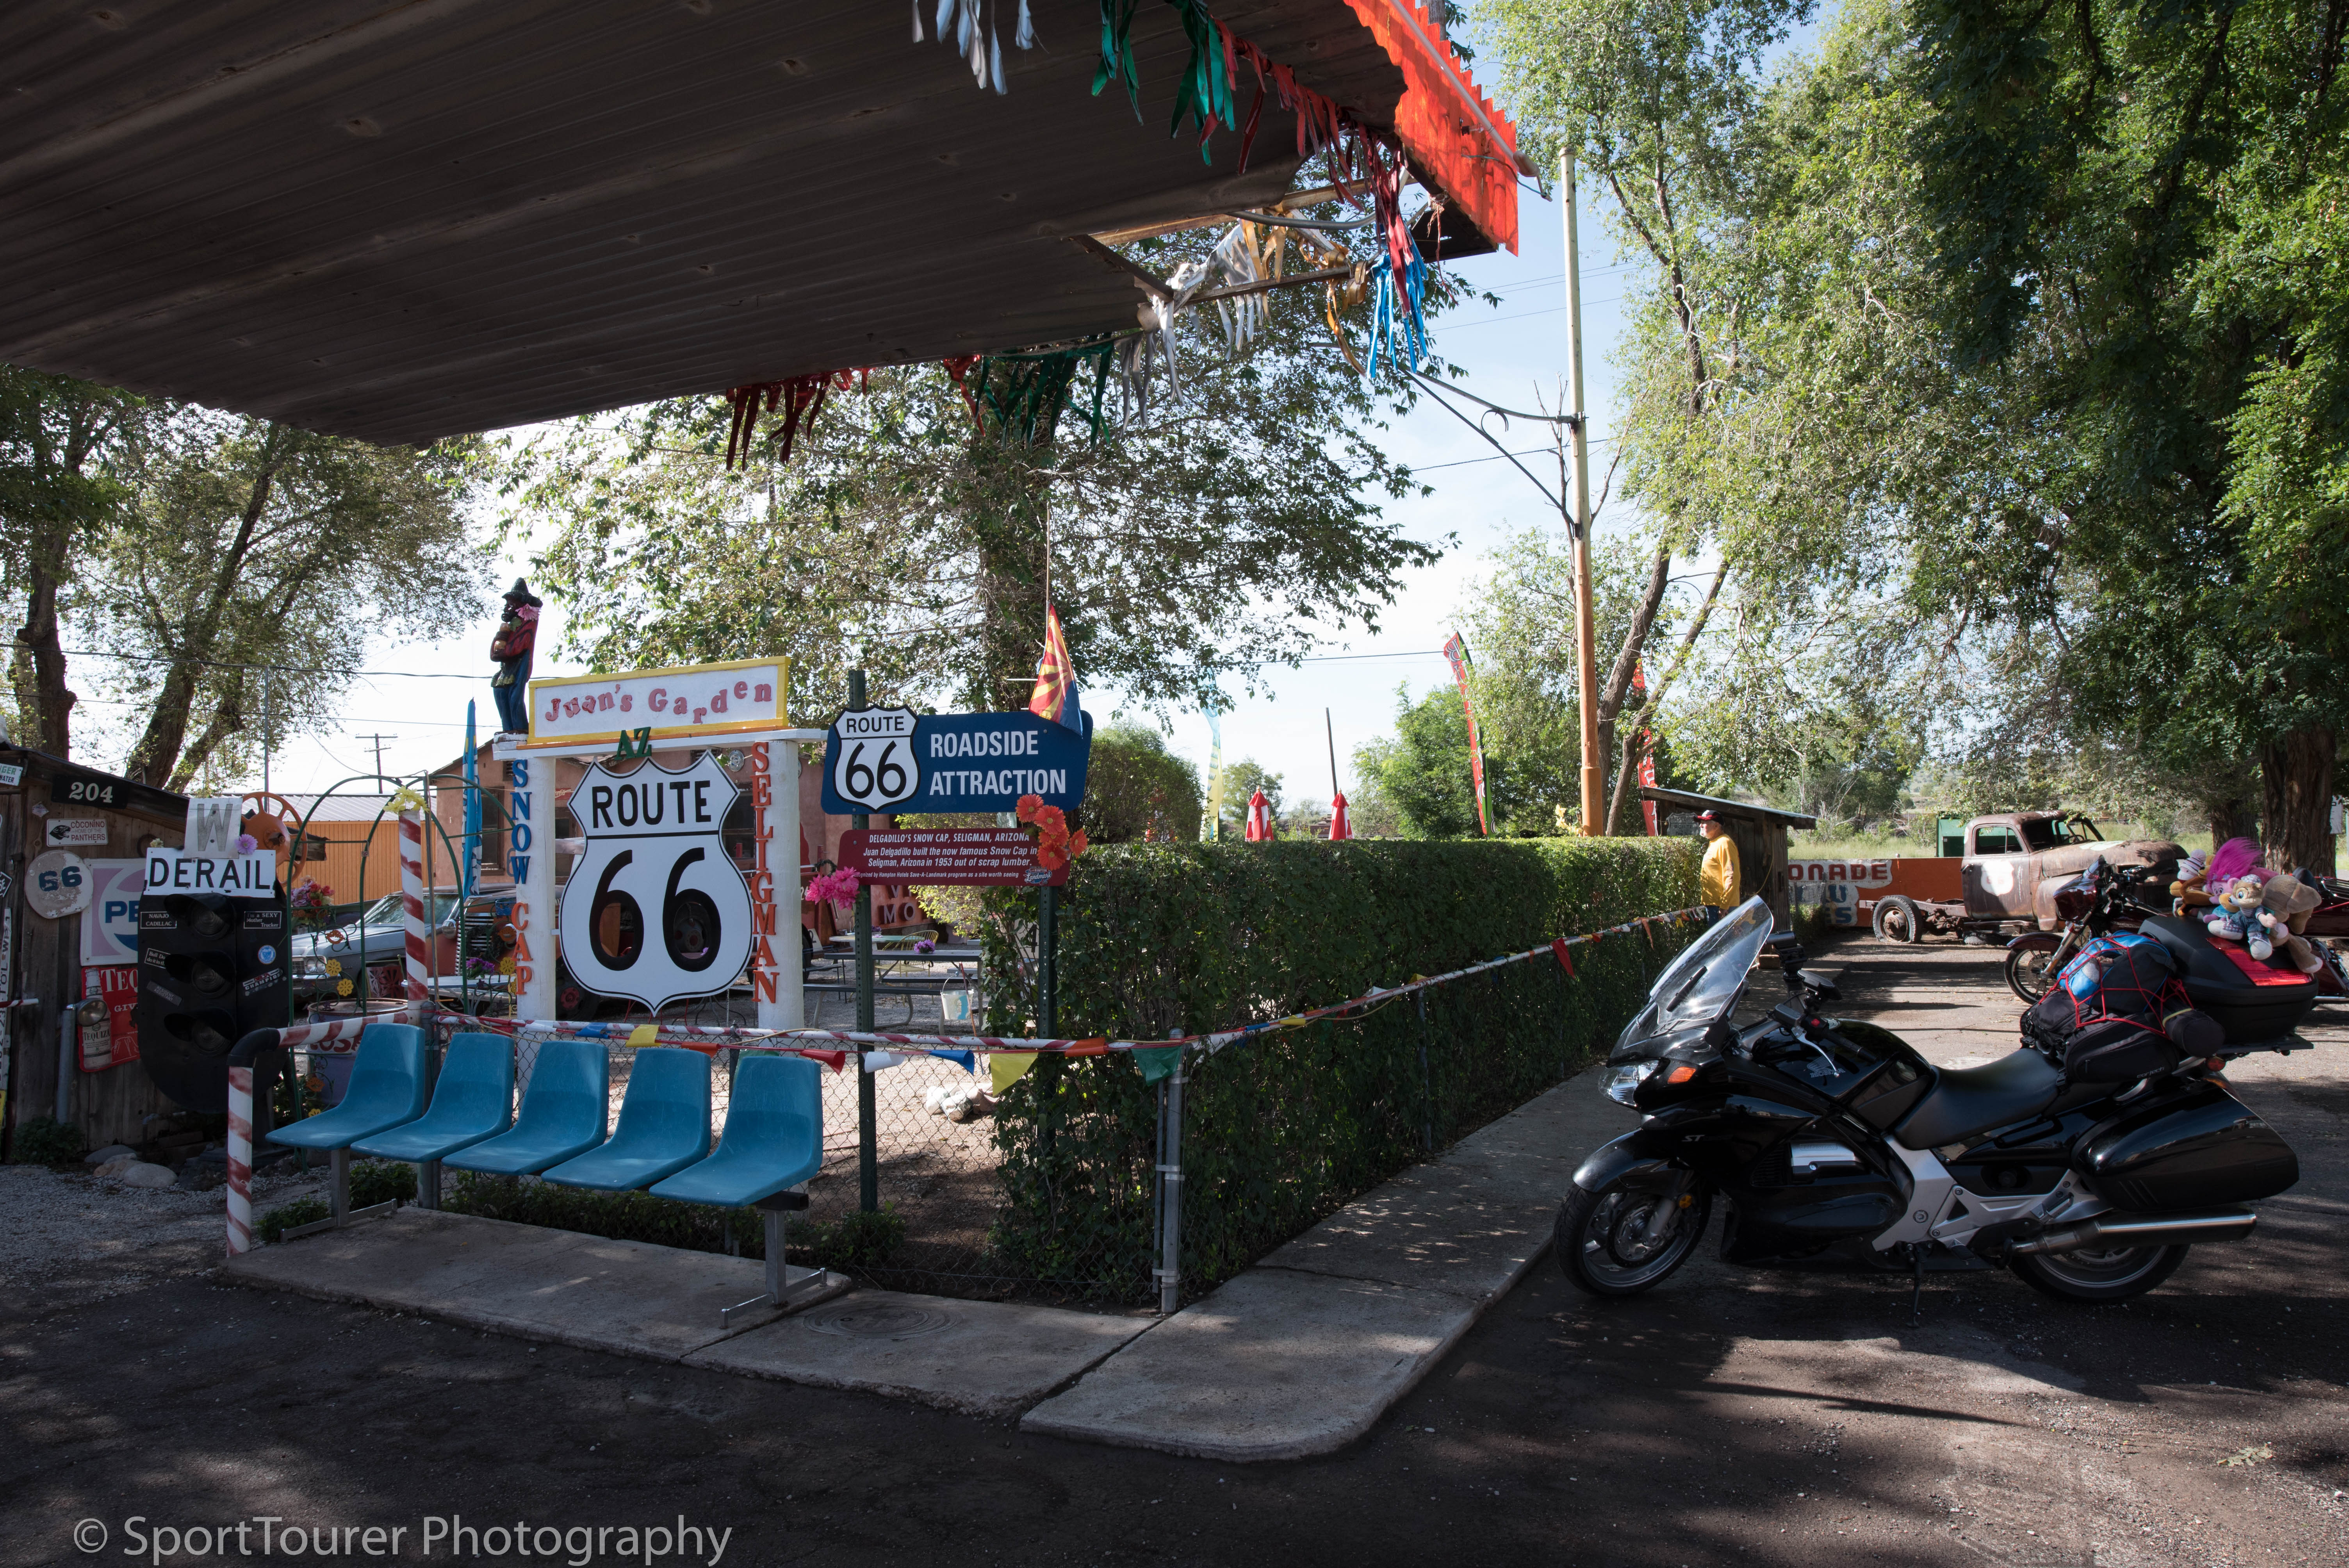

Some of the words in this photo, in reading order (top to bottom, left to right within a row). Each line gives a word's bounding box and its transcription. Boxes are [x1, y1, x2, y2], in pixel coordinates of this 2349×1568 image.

[545, 684, 633, 722] Juan's
[649, 681, 772, 724] Garden
[846, 716, 905, 733] ROUTE
[614, 727, 652, 761] AZ
[931, 730, 1039, 758] ROADSIDE
[0, 764, 16, 775] GER
[845, 740, 907, 799] 66
[929, 769, 1066, 796] ATTRACTION
[69, 782, 113, 803] 204
[592, 779, 712, 829] ROUTE
[197, 803, 233, 852] W
[510, 759, 532, 884] SNOW
[870, 833, 911, 843] DELGADILLO'S
[913, 833, 934, 843] SNOW
[936, 833, 951, 844] CAP,
[954, 833, 992, 843] SELIGMAN,
[995, 832, 1030, 842] ARIZONA
[863, 848, 878, 856] Juan
[880, 847, 911, 858] Delgadillo
[913, 847, 928, 855] built
[929, 847, 941, 855] the
[959, 846, 988, 855] famous
[990, 846, 1011, 855] Snow
[1012, 846, 1028, 857] Cap
[1030, 846, 1037, 854] in
[868, 858, 899, 868] Seligman,
[900, 858, 925, 866] Arizona
[935, 858, 952, 866] 1953
[968, 857, 977, 866] of
[978, 859, 1000, 868] scrap
[1002, 857, 1032, 866] lumber.
[38, 866, 82, 892] 66
[149, 858, 271, 890] DERAIL
[750, 741, 780, 1004] SELIGMAN
[1025, 871, 1051, 882] Landmark
[589, 846, 721, 972] 66
[511, 902, 533, 995] CAP
[83, 1028, 110, 1042] TEQUIZA
[2137, 1067, 2165, 1078] cortech
